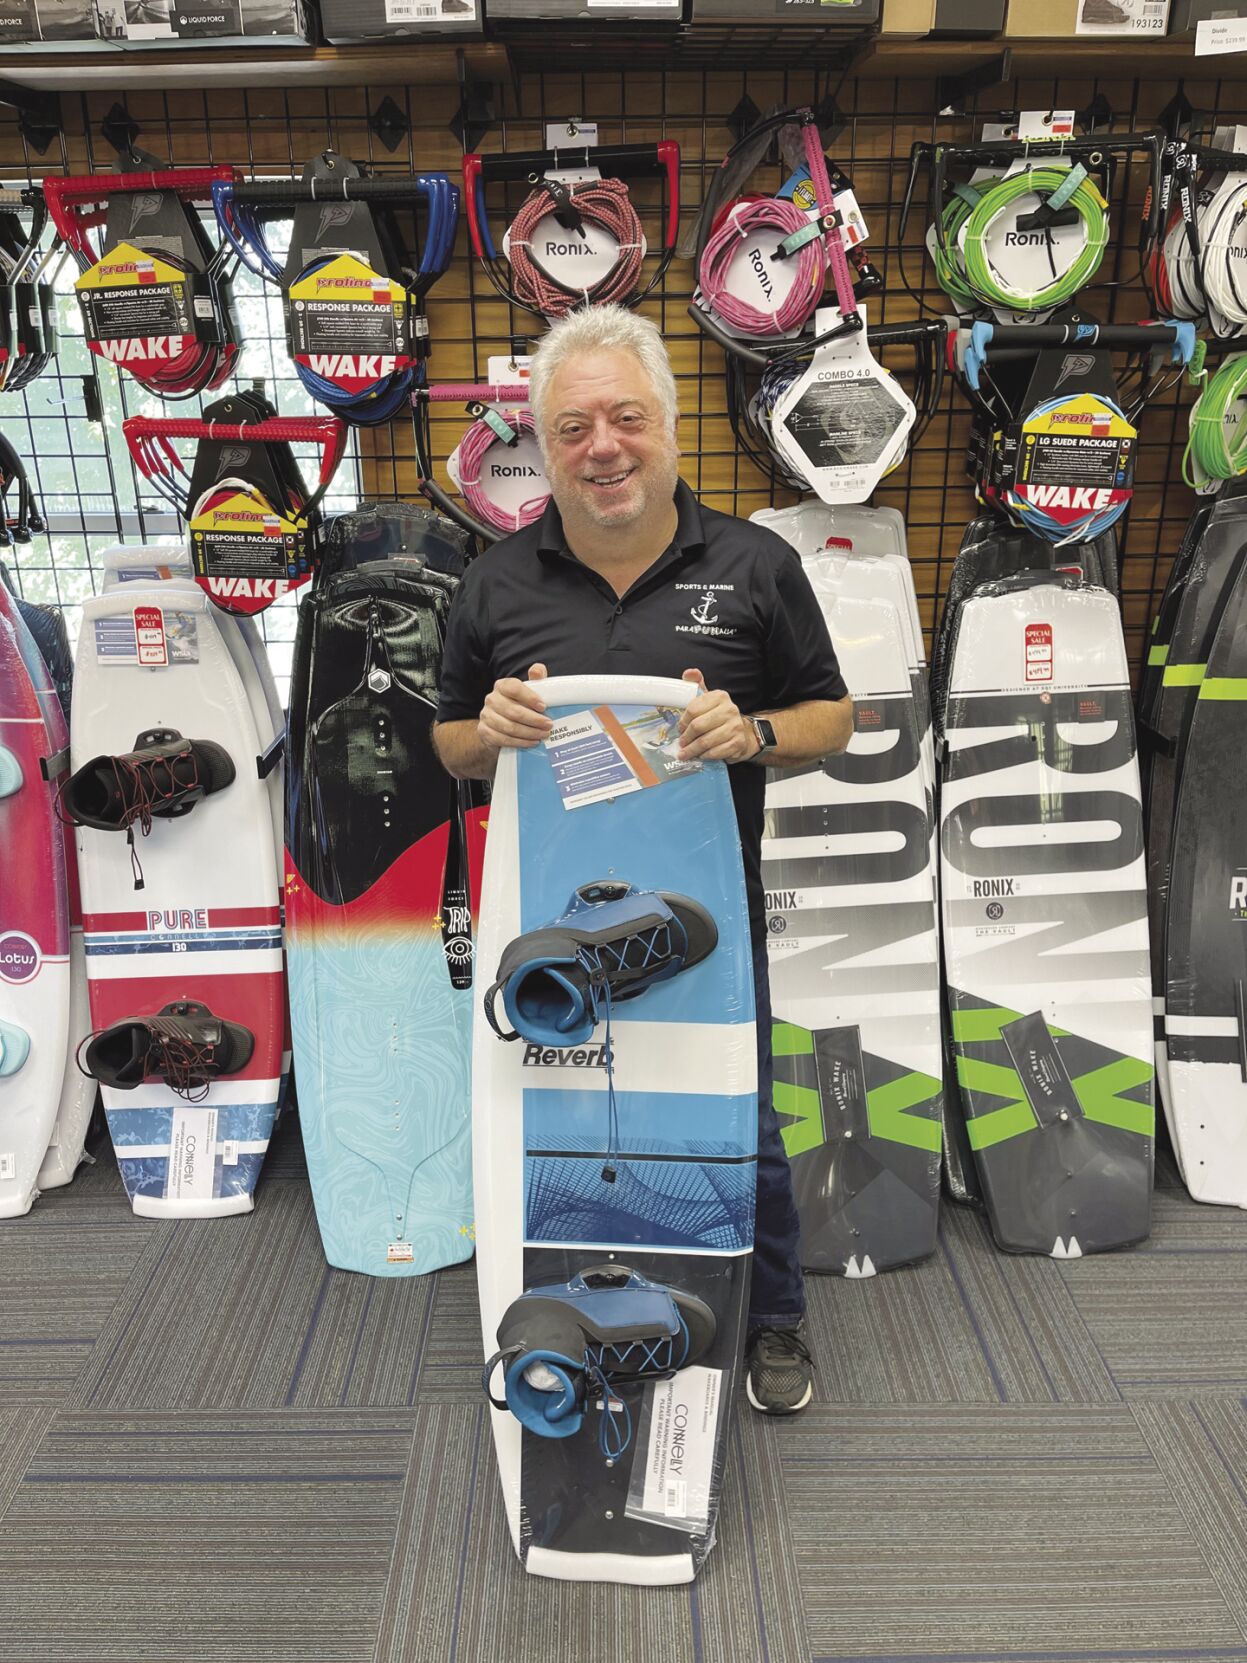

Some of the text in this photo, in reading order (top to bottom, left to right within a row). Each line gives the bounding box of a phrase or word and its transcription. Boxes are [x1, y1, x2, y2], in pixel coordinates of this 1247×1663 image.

[1141, 185, 1153, 221] RONIX
[1160, 174, 1172, 210] RONIX
[1180, 186, 1192, 222] RONIX
[104, 290, 138, 299] RESPONSE
[139, 286, 170, 296] PACKAGE
[308, 304, 391, 313] RESPONSE PACKAGE
[100, 336, 183, 362] WAKE
[309, 355, 396, 378] WAKE
[817, 368, 871, 381] COMBO 4.0
[1039, 436, 1118, 448] LG SUEDE PACKAGE
[1026, 485, 1114, 510] WAKE
[206, 534, 282, 544] RESPONSE PACKAGE
[208, 577, 290, 598] WAKE
[550, 725, 592, 742] RESPONSIBLY
[974, 878, 1014, 898] RONIX
[766, 891, 797, 910] ONIX
[148, 908, 207, 931] PURE
[443, 906, 471, 934] TRIP
[172, 942, 187, 952] 130
[522, 1044, 615, 1066] Reverb
[658, 1382, 674, 1494] IMPORTANT WARNING INFORMATION
[653, 1438, 662, 1474] CAREFULLY
